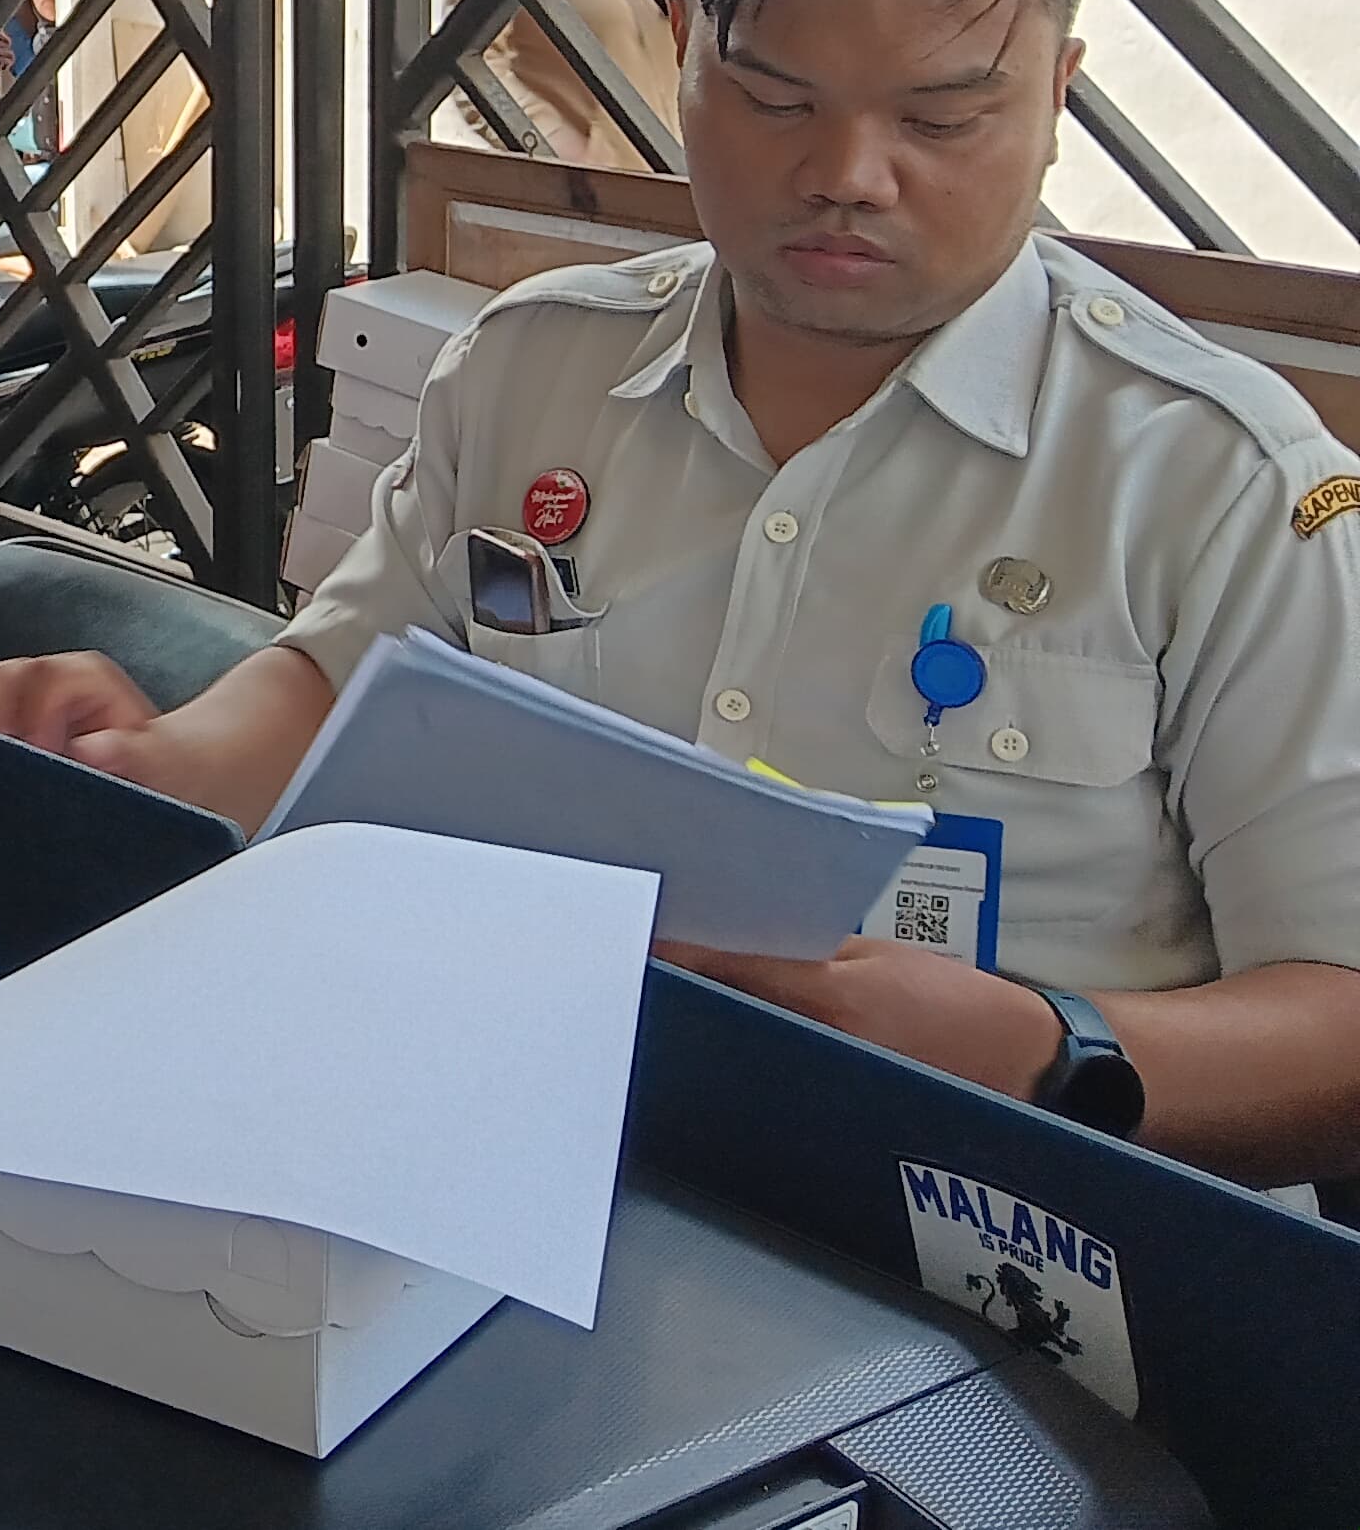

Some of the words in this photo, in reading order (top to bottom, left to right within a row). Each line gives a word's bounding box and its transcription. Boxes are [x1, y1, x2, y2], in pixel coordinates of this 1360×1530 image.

[1297, 481, 1360, 528] BAPEN
[903, 1164, 1113, 1290] MALANG
[979, 1231, 995, 1252] IS
[999, 1238, 1045, 1274] PRIDE
